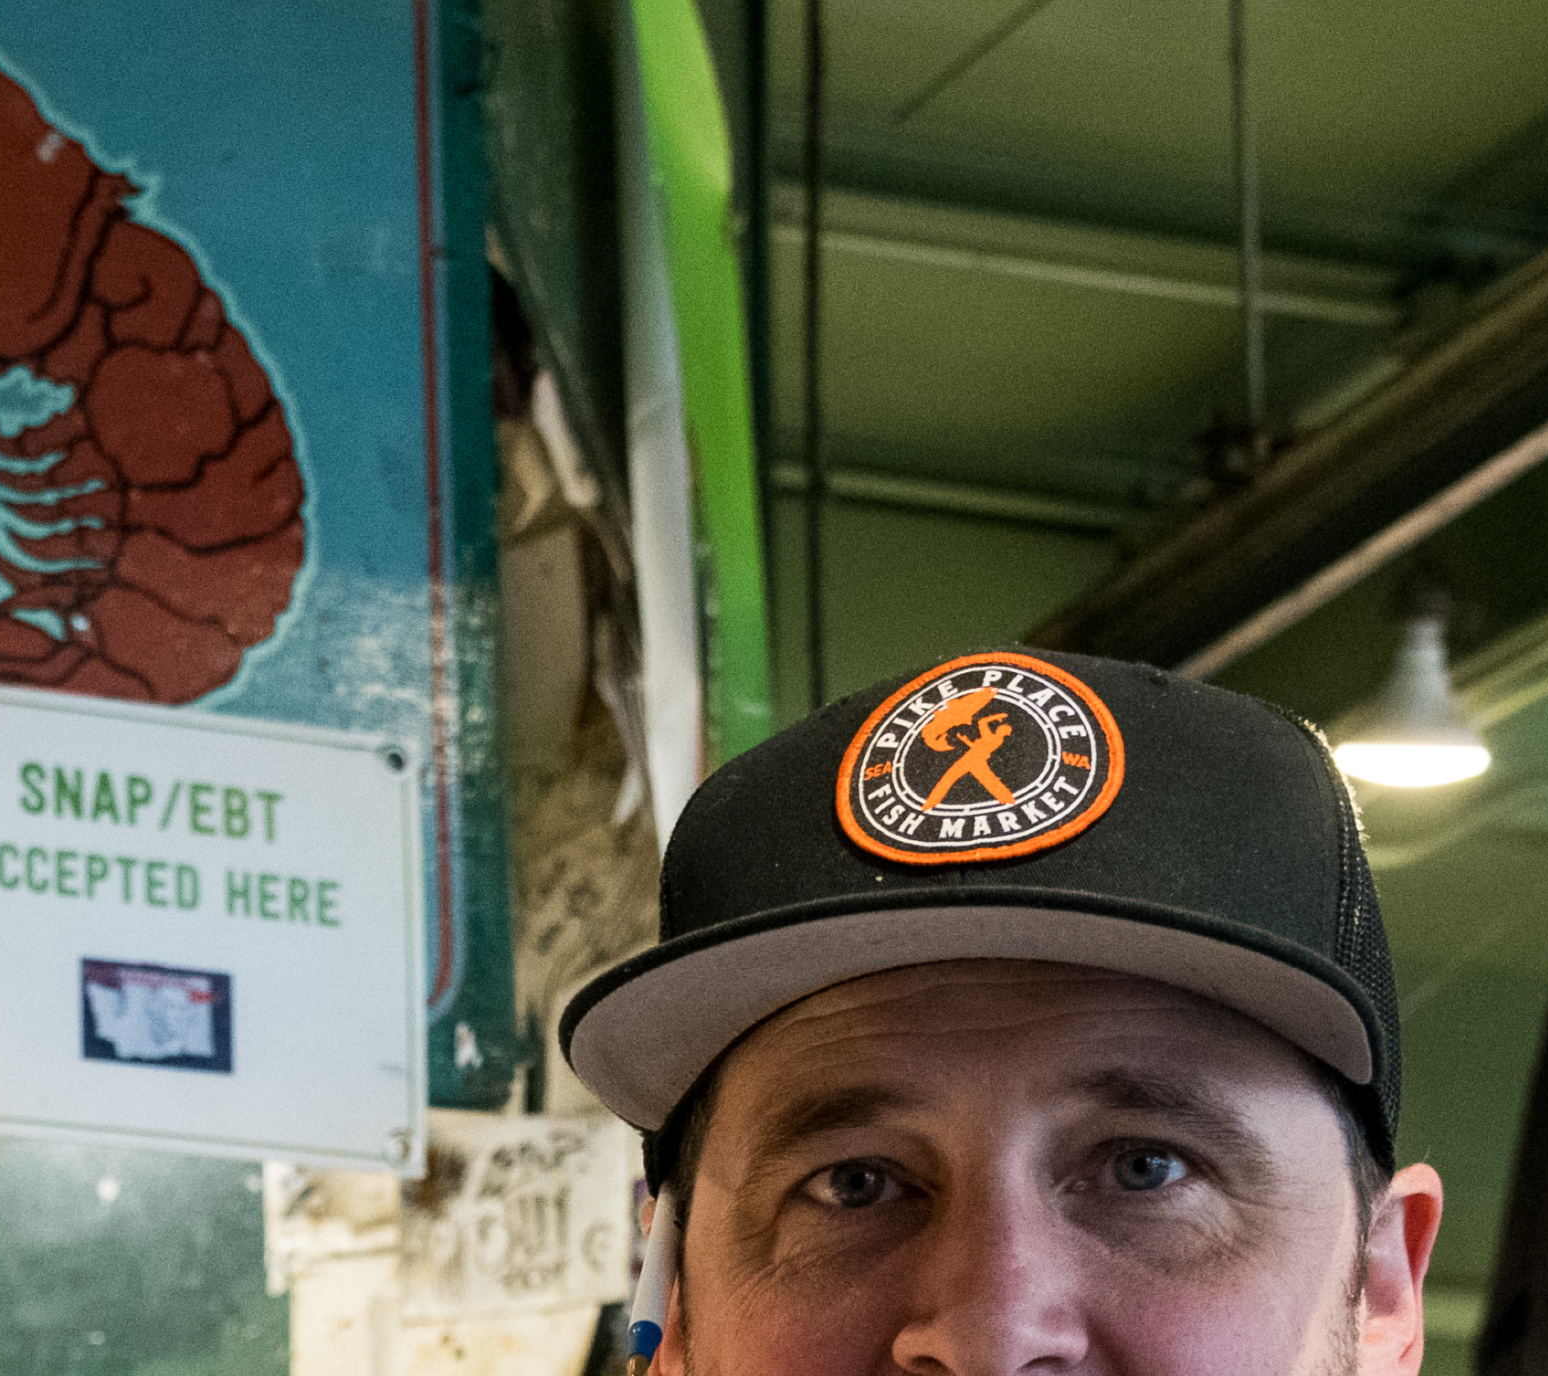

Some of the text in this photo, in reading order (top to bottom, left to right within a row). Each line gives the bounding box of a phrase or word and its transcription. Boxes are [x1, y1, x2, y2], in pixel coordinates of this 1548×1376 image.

[876, 670, 1087, 748] PIKE PLACE
[864, 760, 892, 781] SEA
[1061, 751, 1091, 770] WA
[19, 761, 285, 843] SNAP/EBT
[868, 776, 1079, 839] FISH MARKET
[226, 870, 343, 929] HERE
